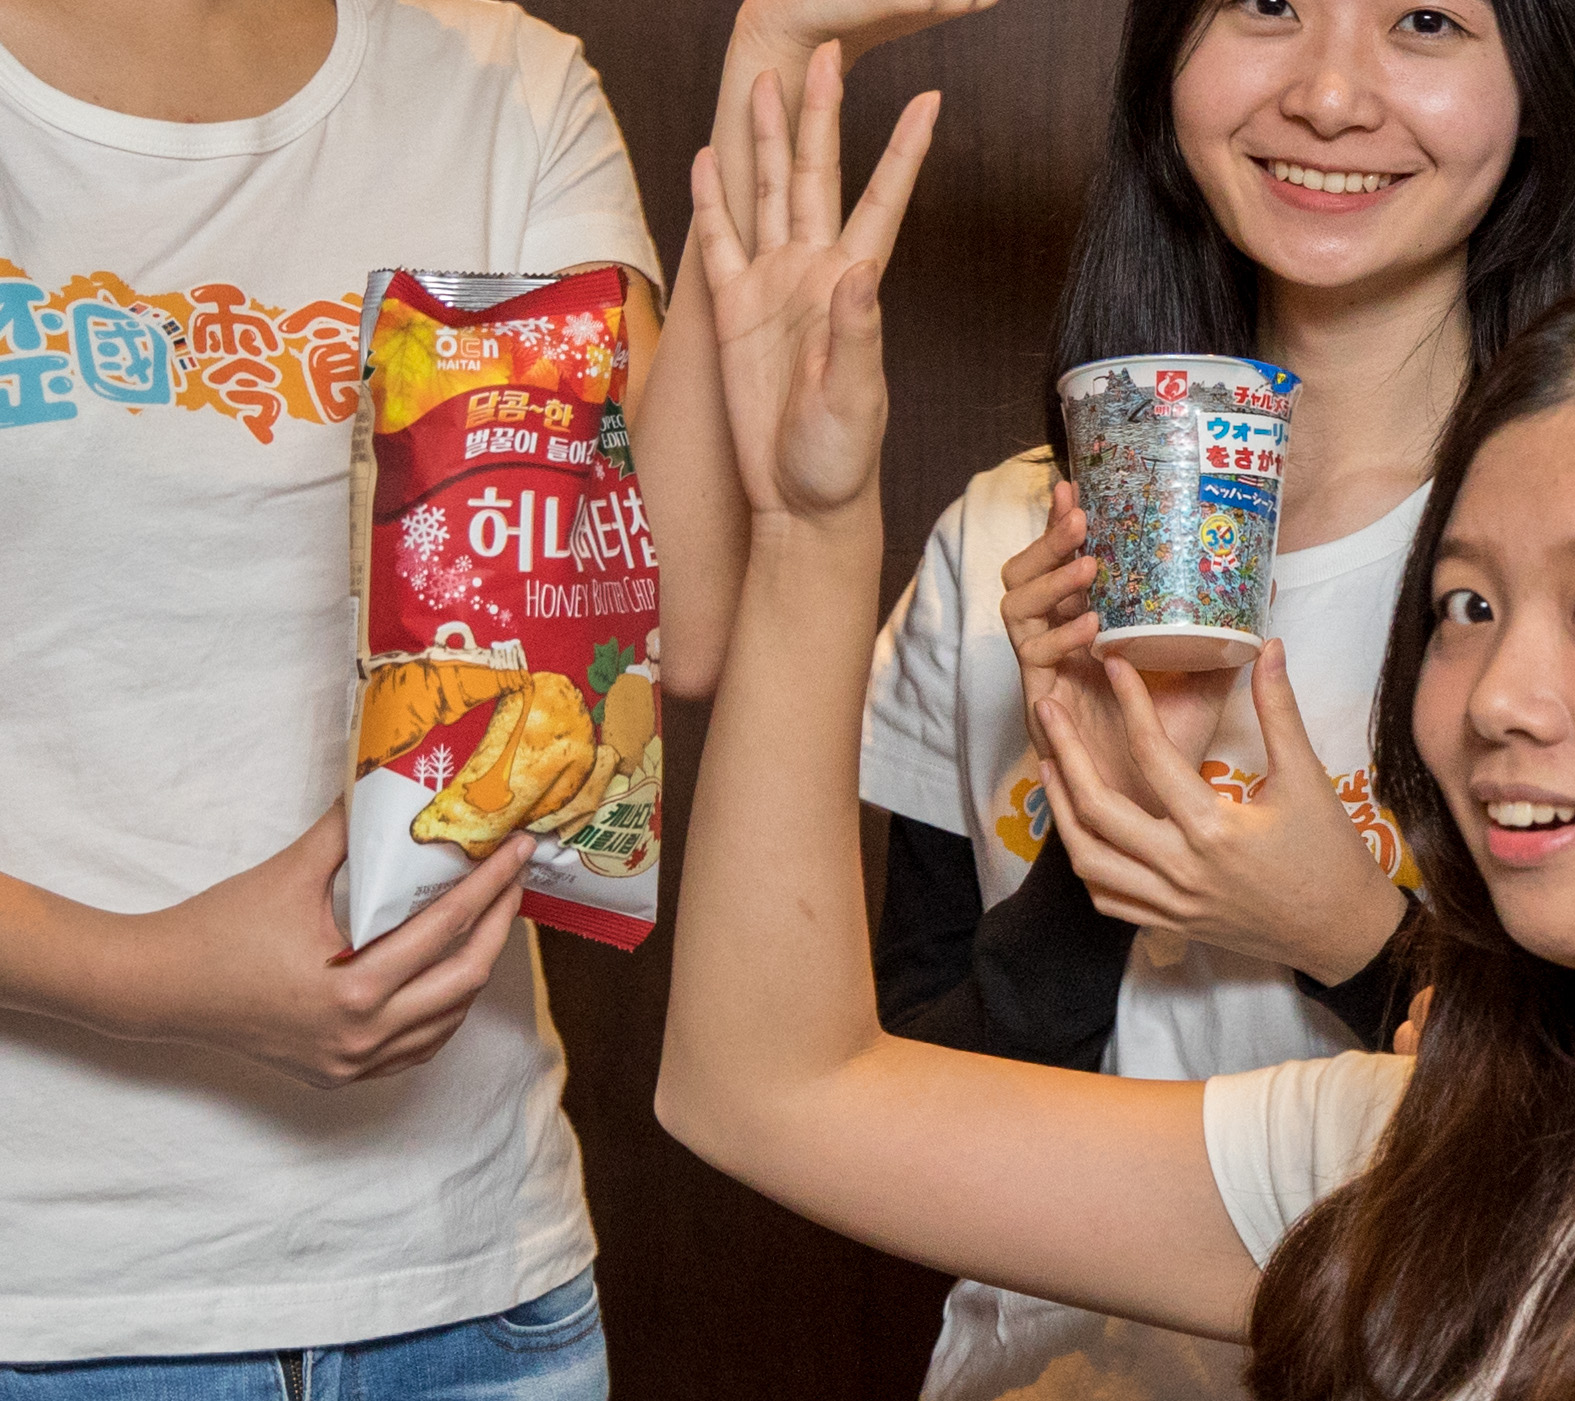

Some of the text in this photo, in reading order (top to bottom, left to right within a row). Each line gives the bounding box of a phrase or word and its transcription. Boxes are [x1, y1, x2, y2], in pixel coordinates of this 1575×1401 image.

[437, 359, 481, 371] HAITAI
[600, 413, 625, 432] SPEC
[464, 427, 538, 460] 벌꿀이
[600, 431, 630, 449] EDITI
[526, 579, 590, 619] HONEY
[623, 576, 656, 613] CHIP
